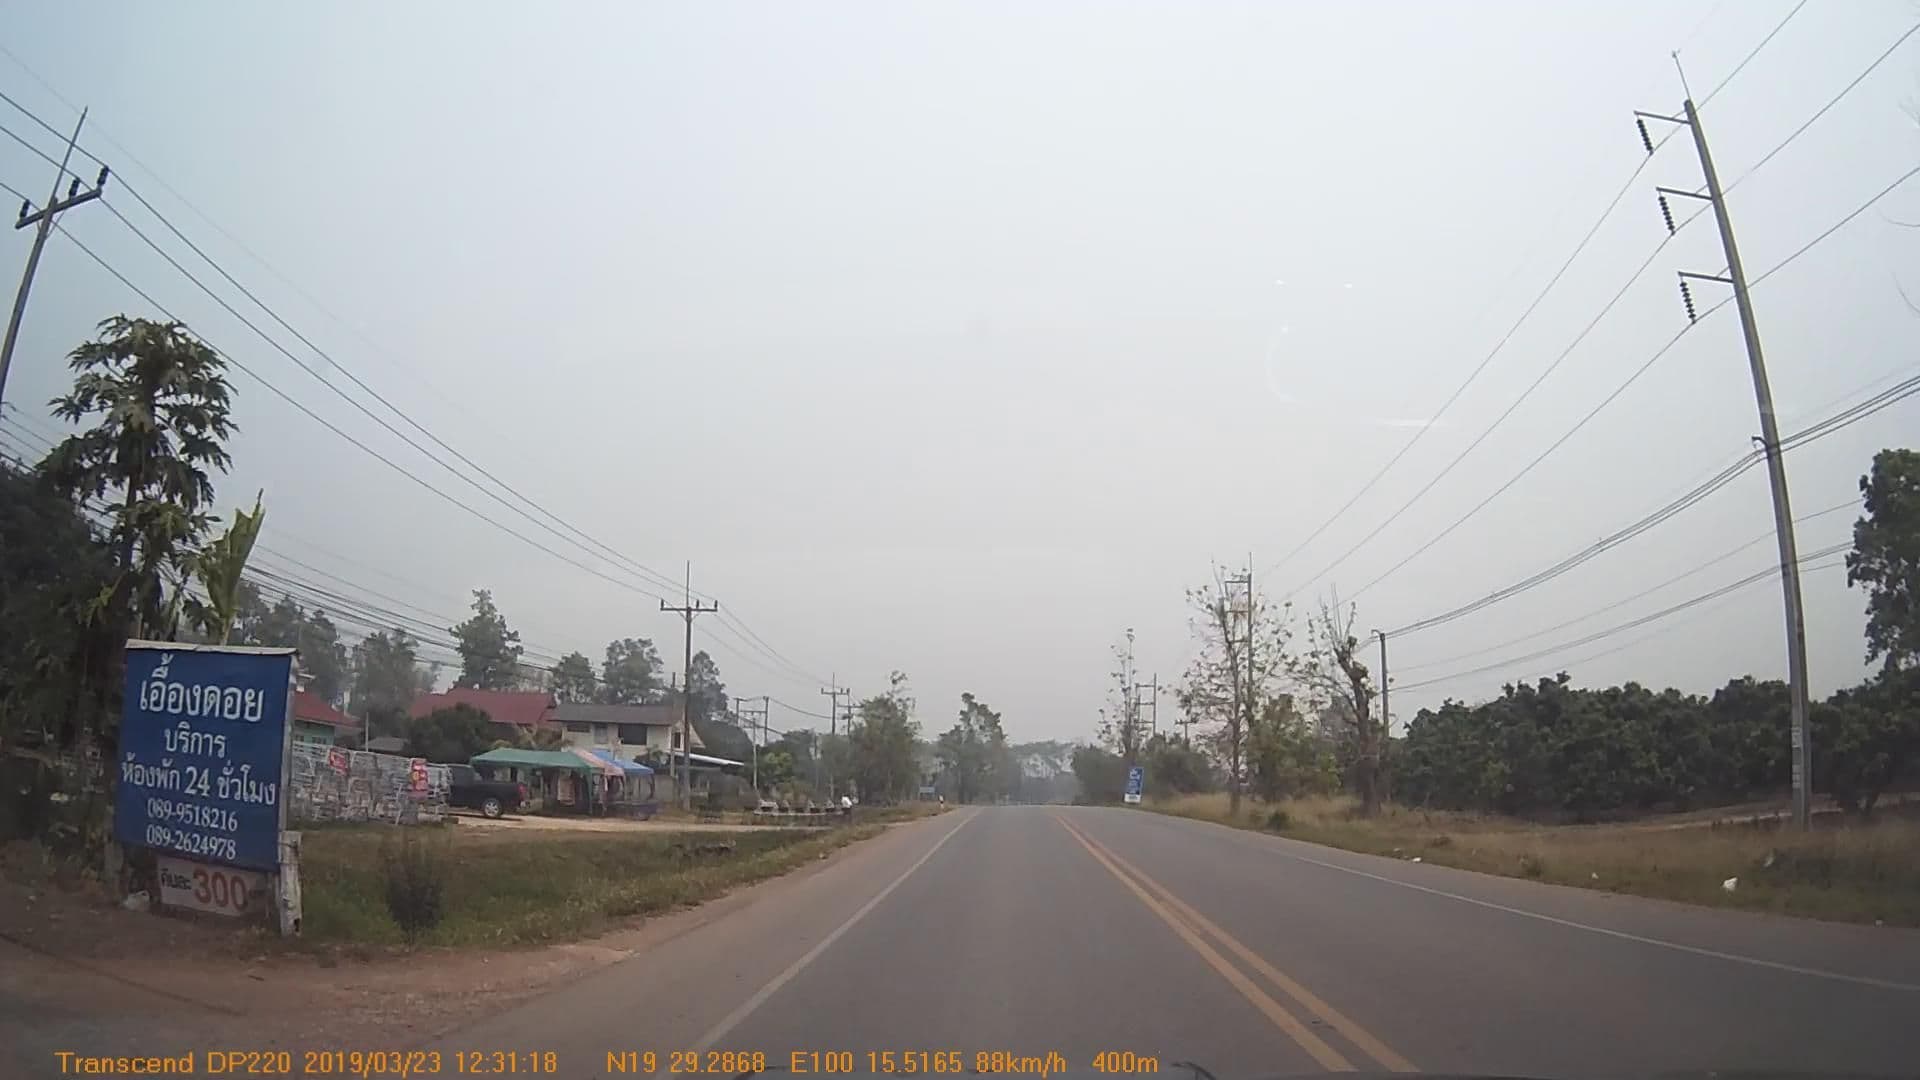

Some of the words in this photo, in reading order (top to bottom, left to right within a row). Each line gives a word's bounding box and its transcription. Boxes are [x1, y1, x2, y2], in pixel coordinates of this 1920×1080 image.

[140, 653, 264, 722] เอื้องดอย
[164, 721, 227, 759] บริการ
[121, 752, 181, 792] ห้องพัก
[184, 765, 210, 797] 24
[217, 760, 277, 806] ชั่วโมง
[147, 797, 239, 832] 089-9518216
[146, 825, 237, 860] 089-2624978
